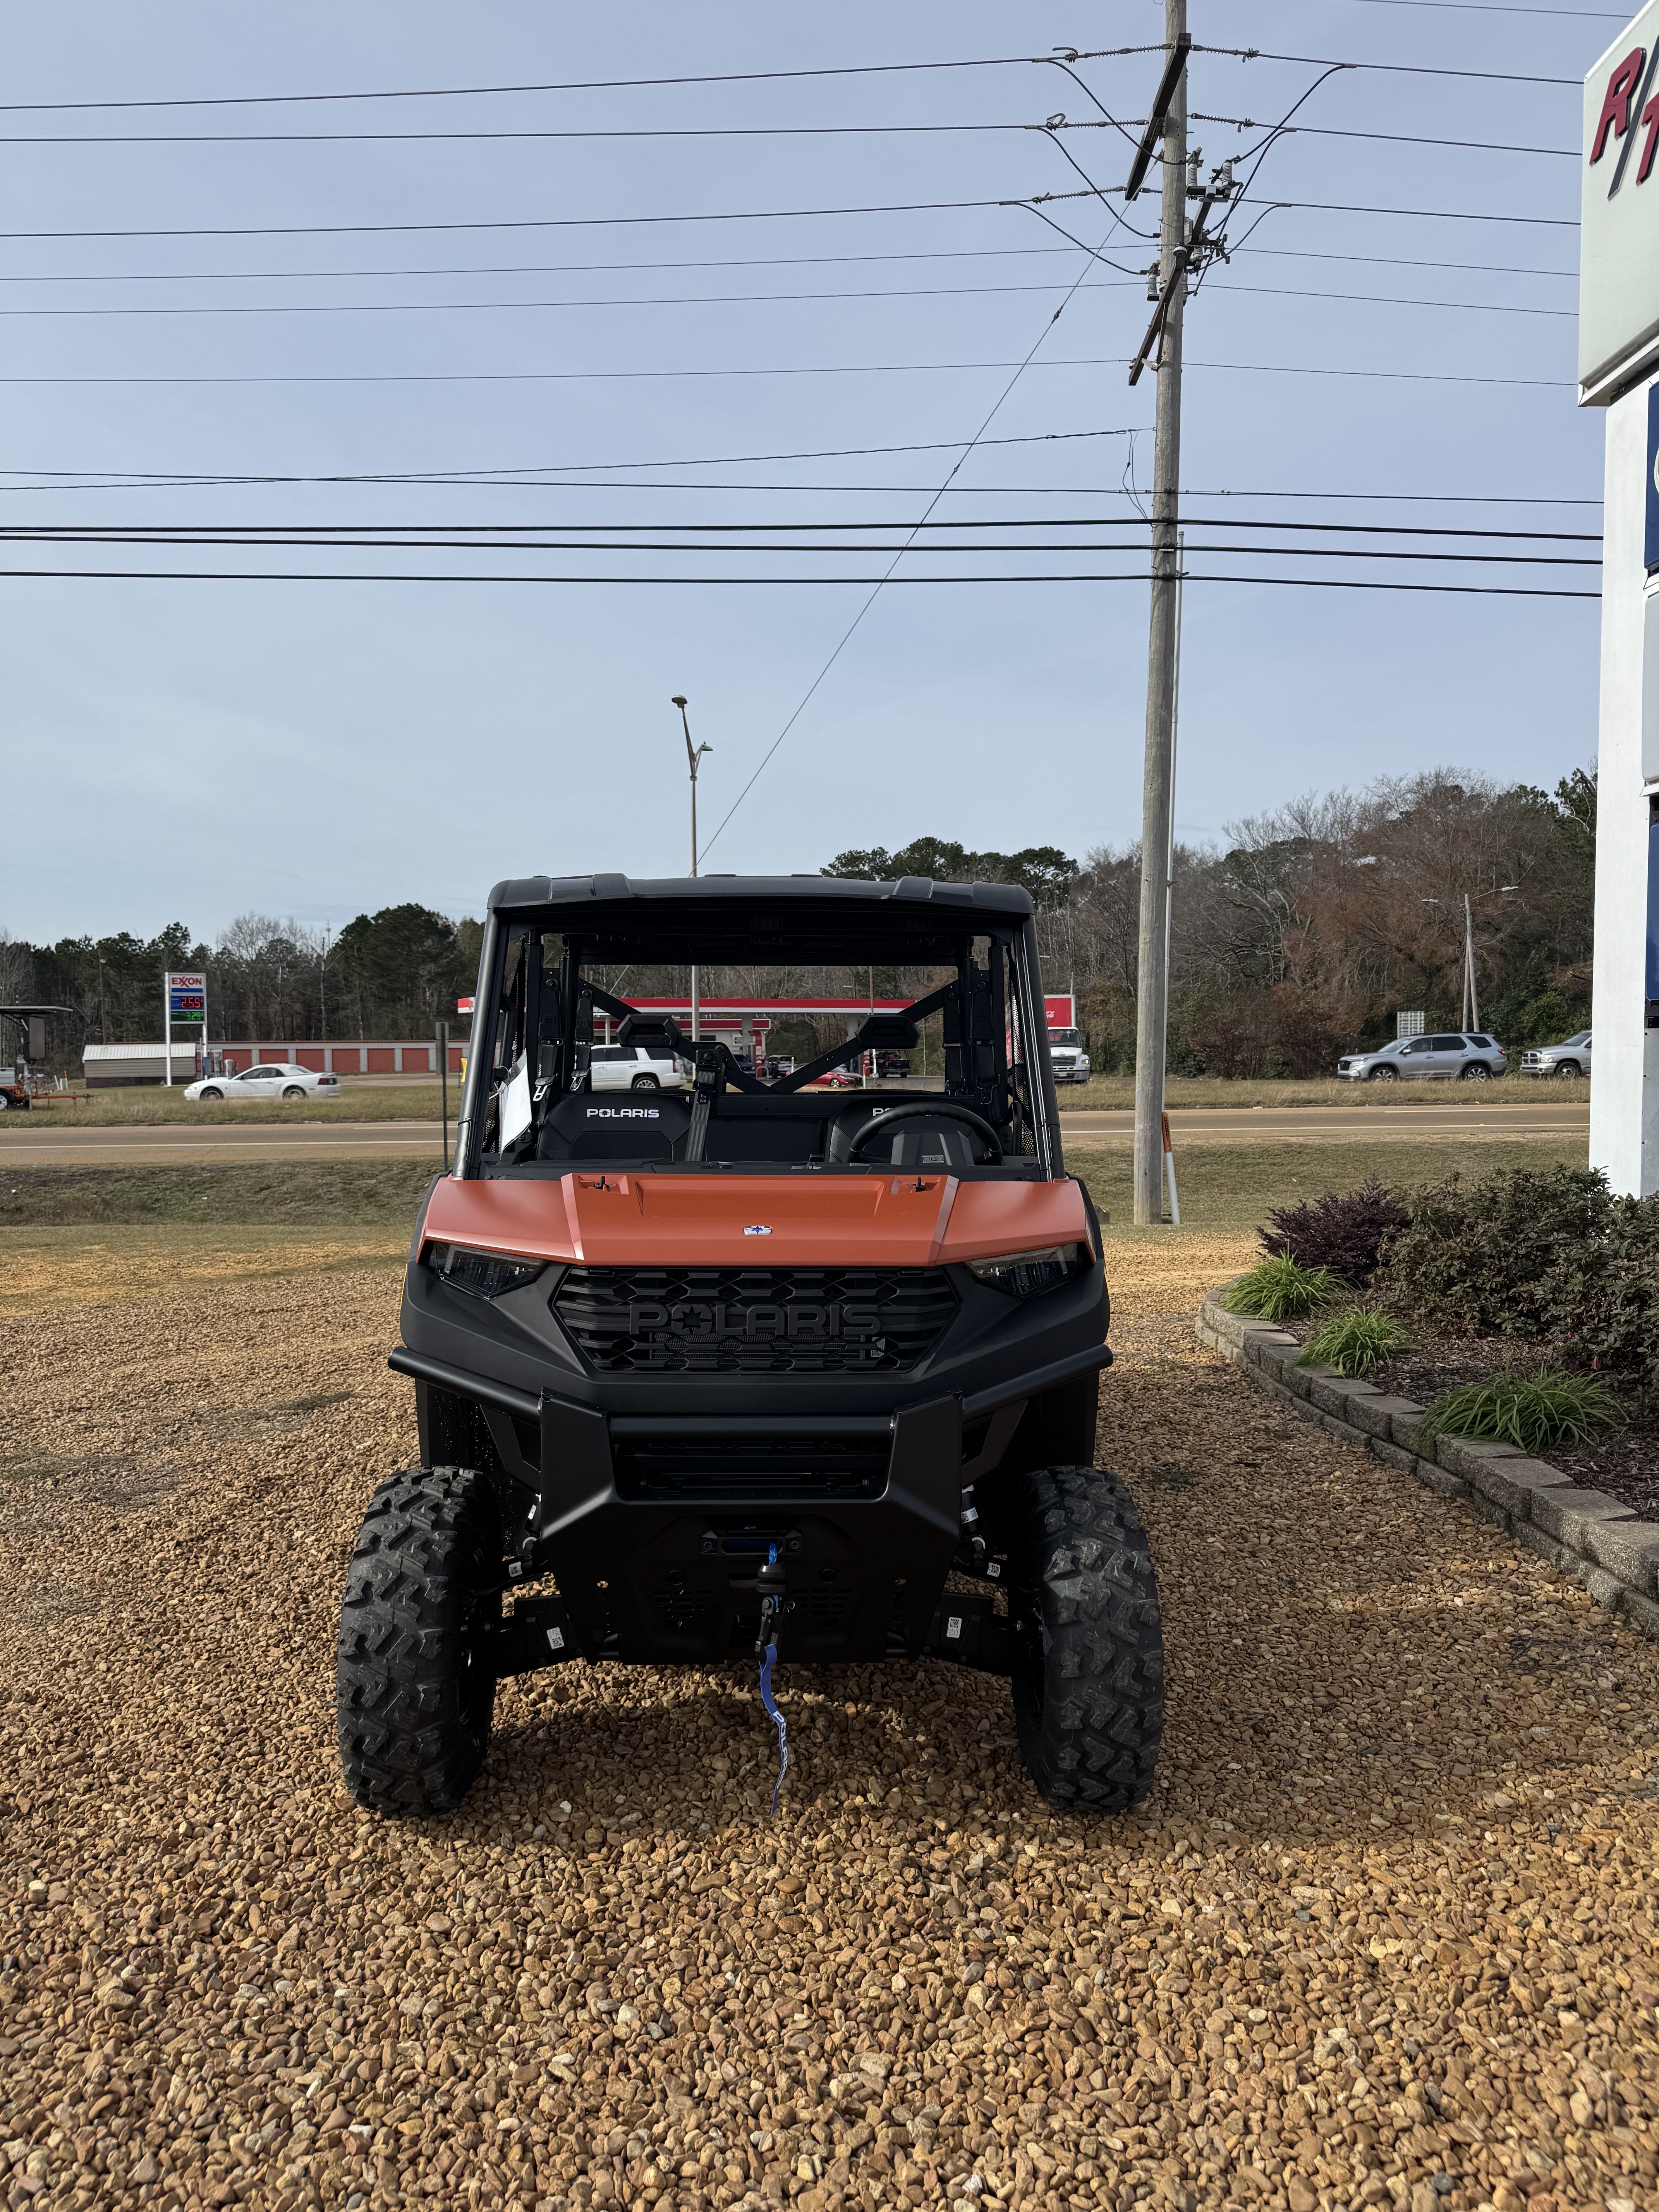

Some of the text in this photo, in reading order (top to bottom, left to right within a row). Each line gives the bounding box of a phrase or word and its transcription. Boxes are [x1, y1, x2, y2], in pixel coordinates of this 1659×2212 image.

[172, 976, 202, 988] EXXON
[587, 1109, 659, 1118] POLARIS
[630, 1304, 881, 1336] POLARIS
